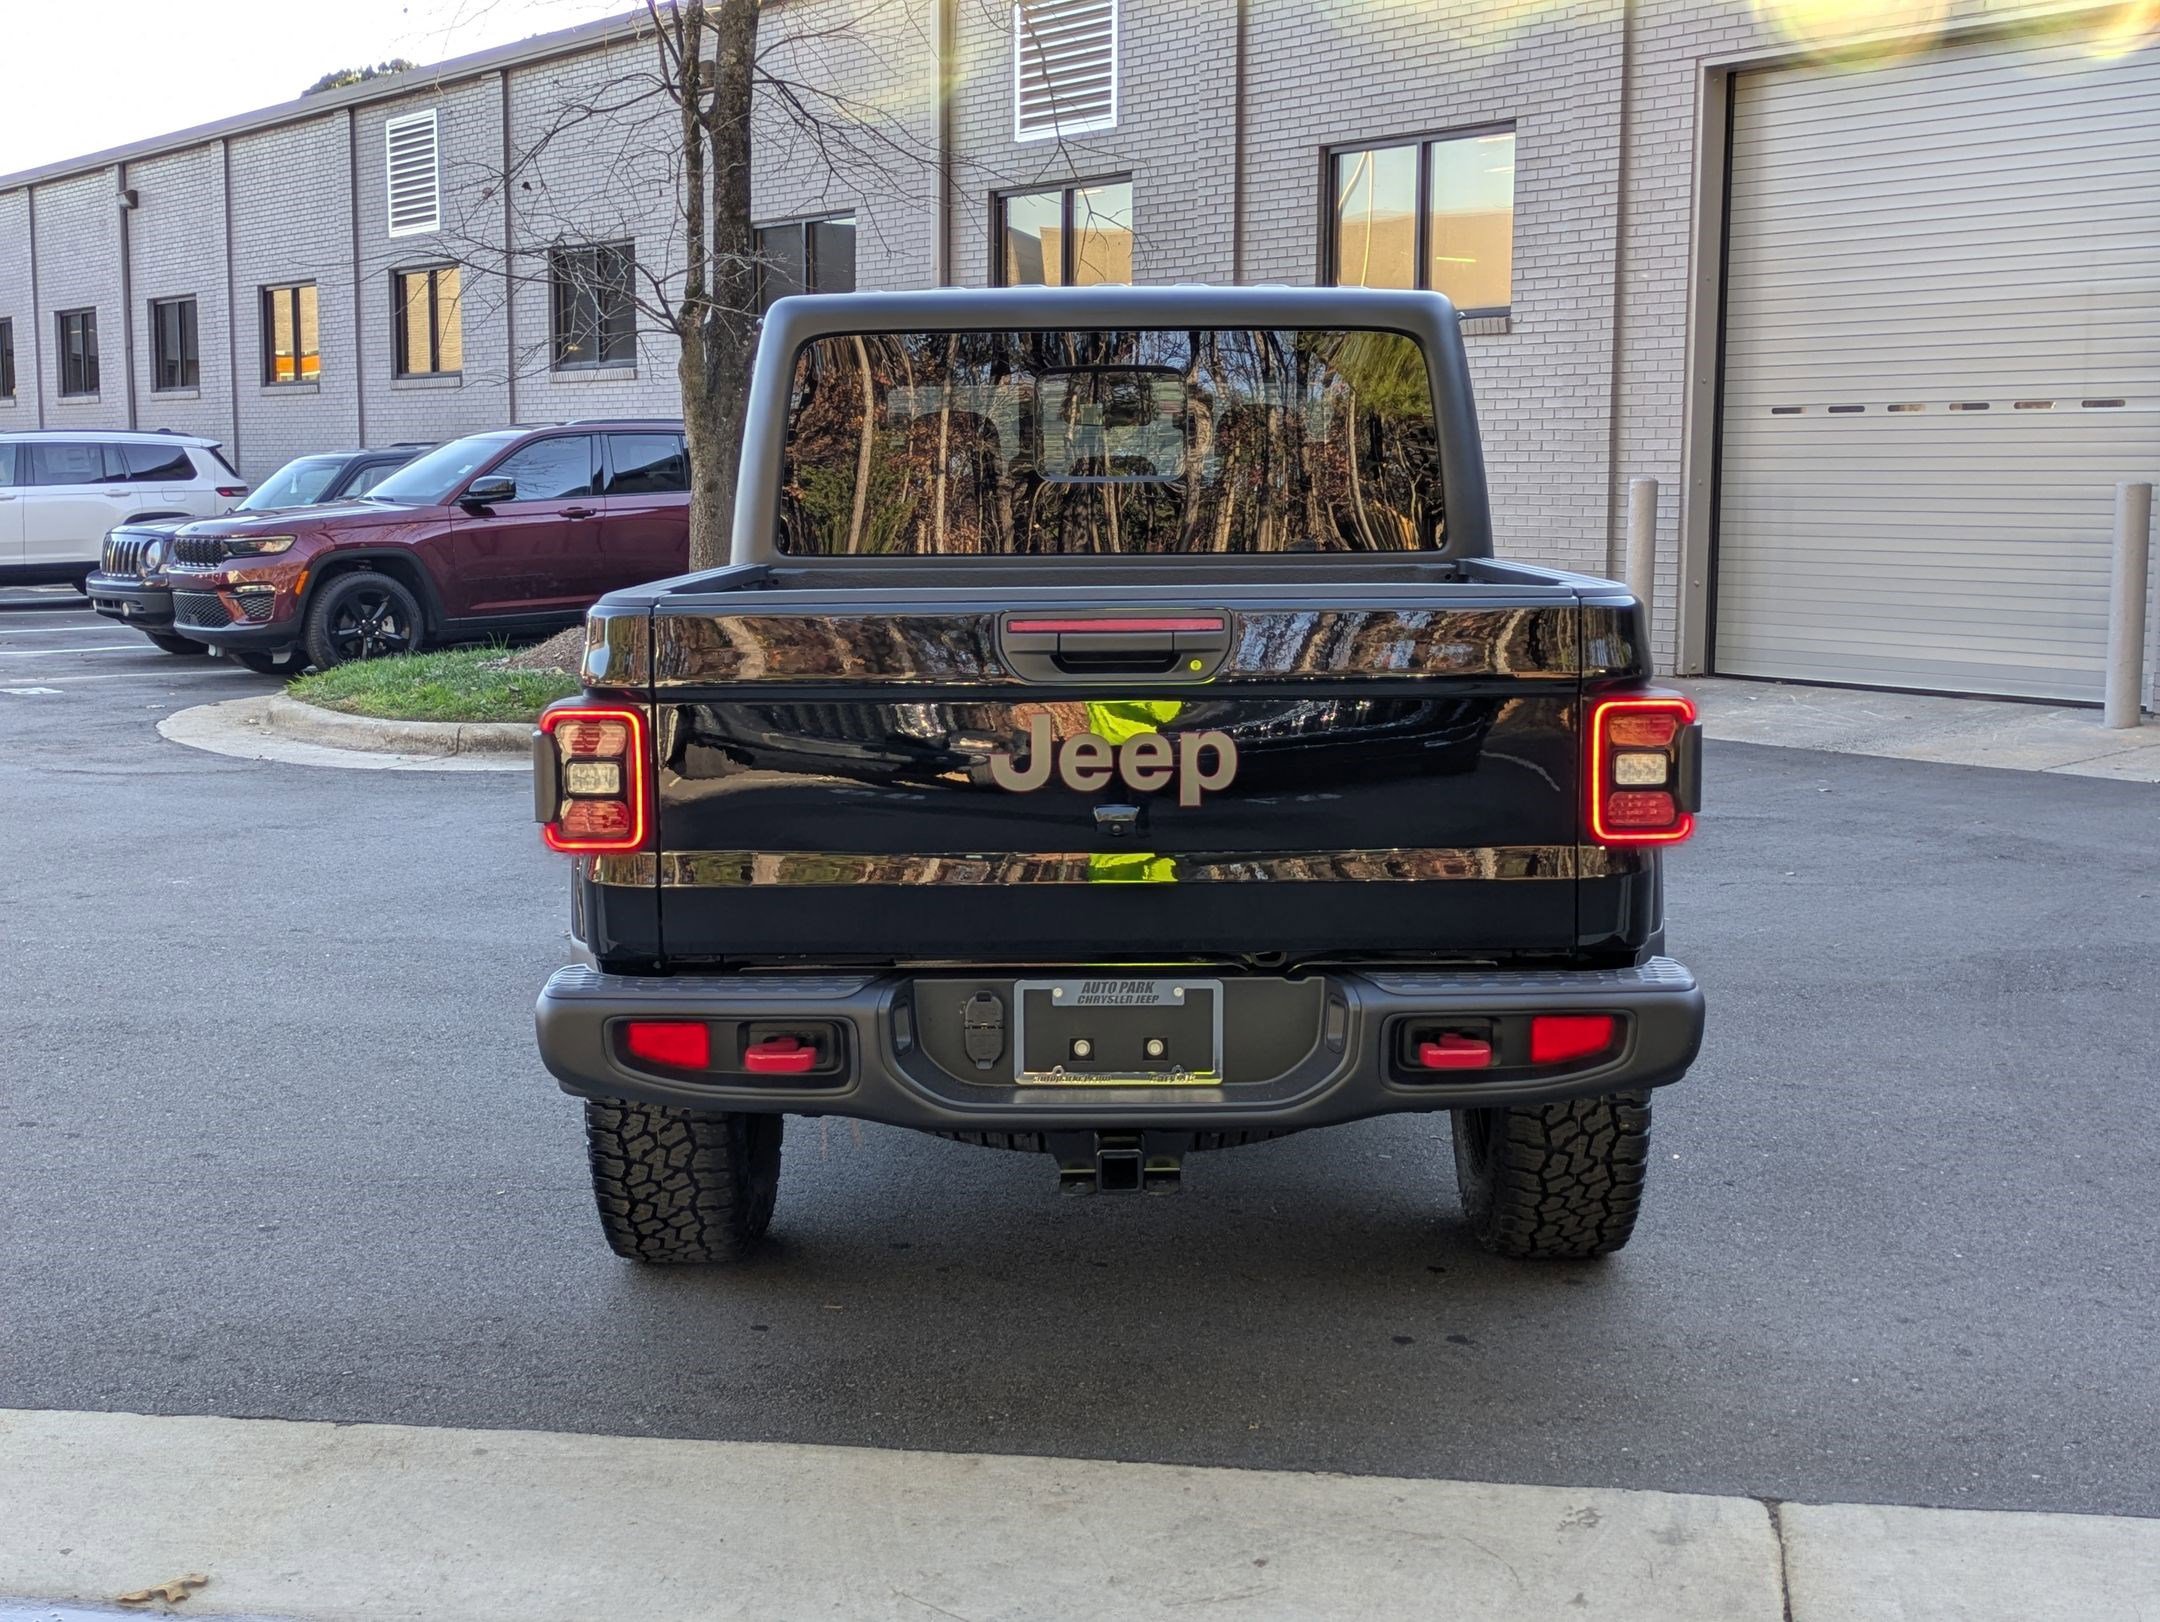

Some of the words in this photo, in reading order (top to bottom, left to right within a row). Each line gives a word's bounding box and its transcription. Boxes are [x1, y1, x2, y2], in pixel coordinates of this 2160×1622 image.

[989, 713, 1238, 807] Jeep
[1081, 981, 1118, 994] AUTO
[1119, 981, 1155, 994] PARK
[1077, 995, 1133, 1004] CHRYSLER
[1134, 995, 1160, 1004] JEEP
